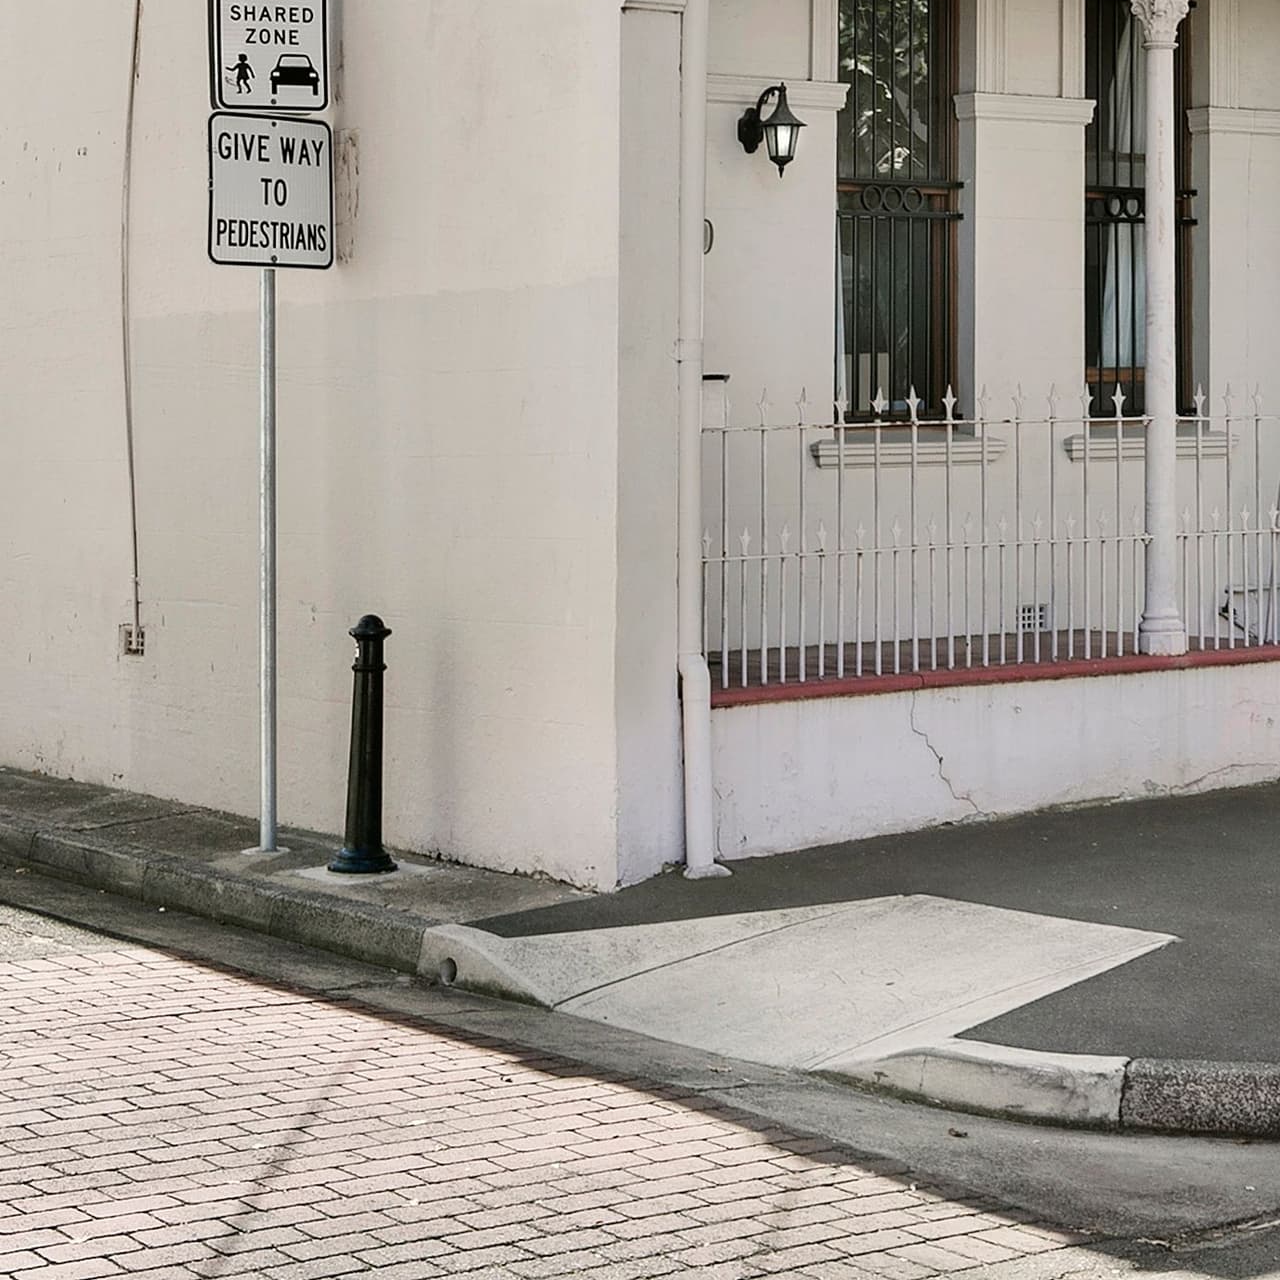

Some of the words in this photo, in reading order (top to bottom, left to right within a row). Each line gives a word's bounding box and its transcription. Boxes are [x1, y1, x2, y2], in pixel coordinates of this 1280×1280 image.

[230, 5, 314, 23] SHARED
[245, 28, 299, 46] ZONE
[218, 132, 271, 163] GIVE
[280, 136, 324, 167] WAY
[260, 178, 287, 207] TO
[216, 218, 327, 252] PEDESTRIANS
